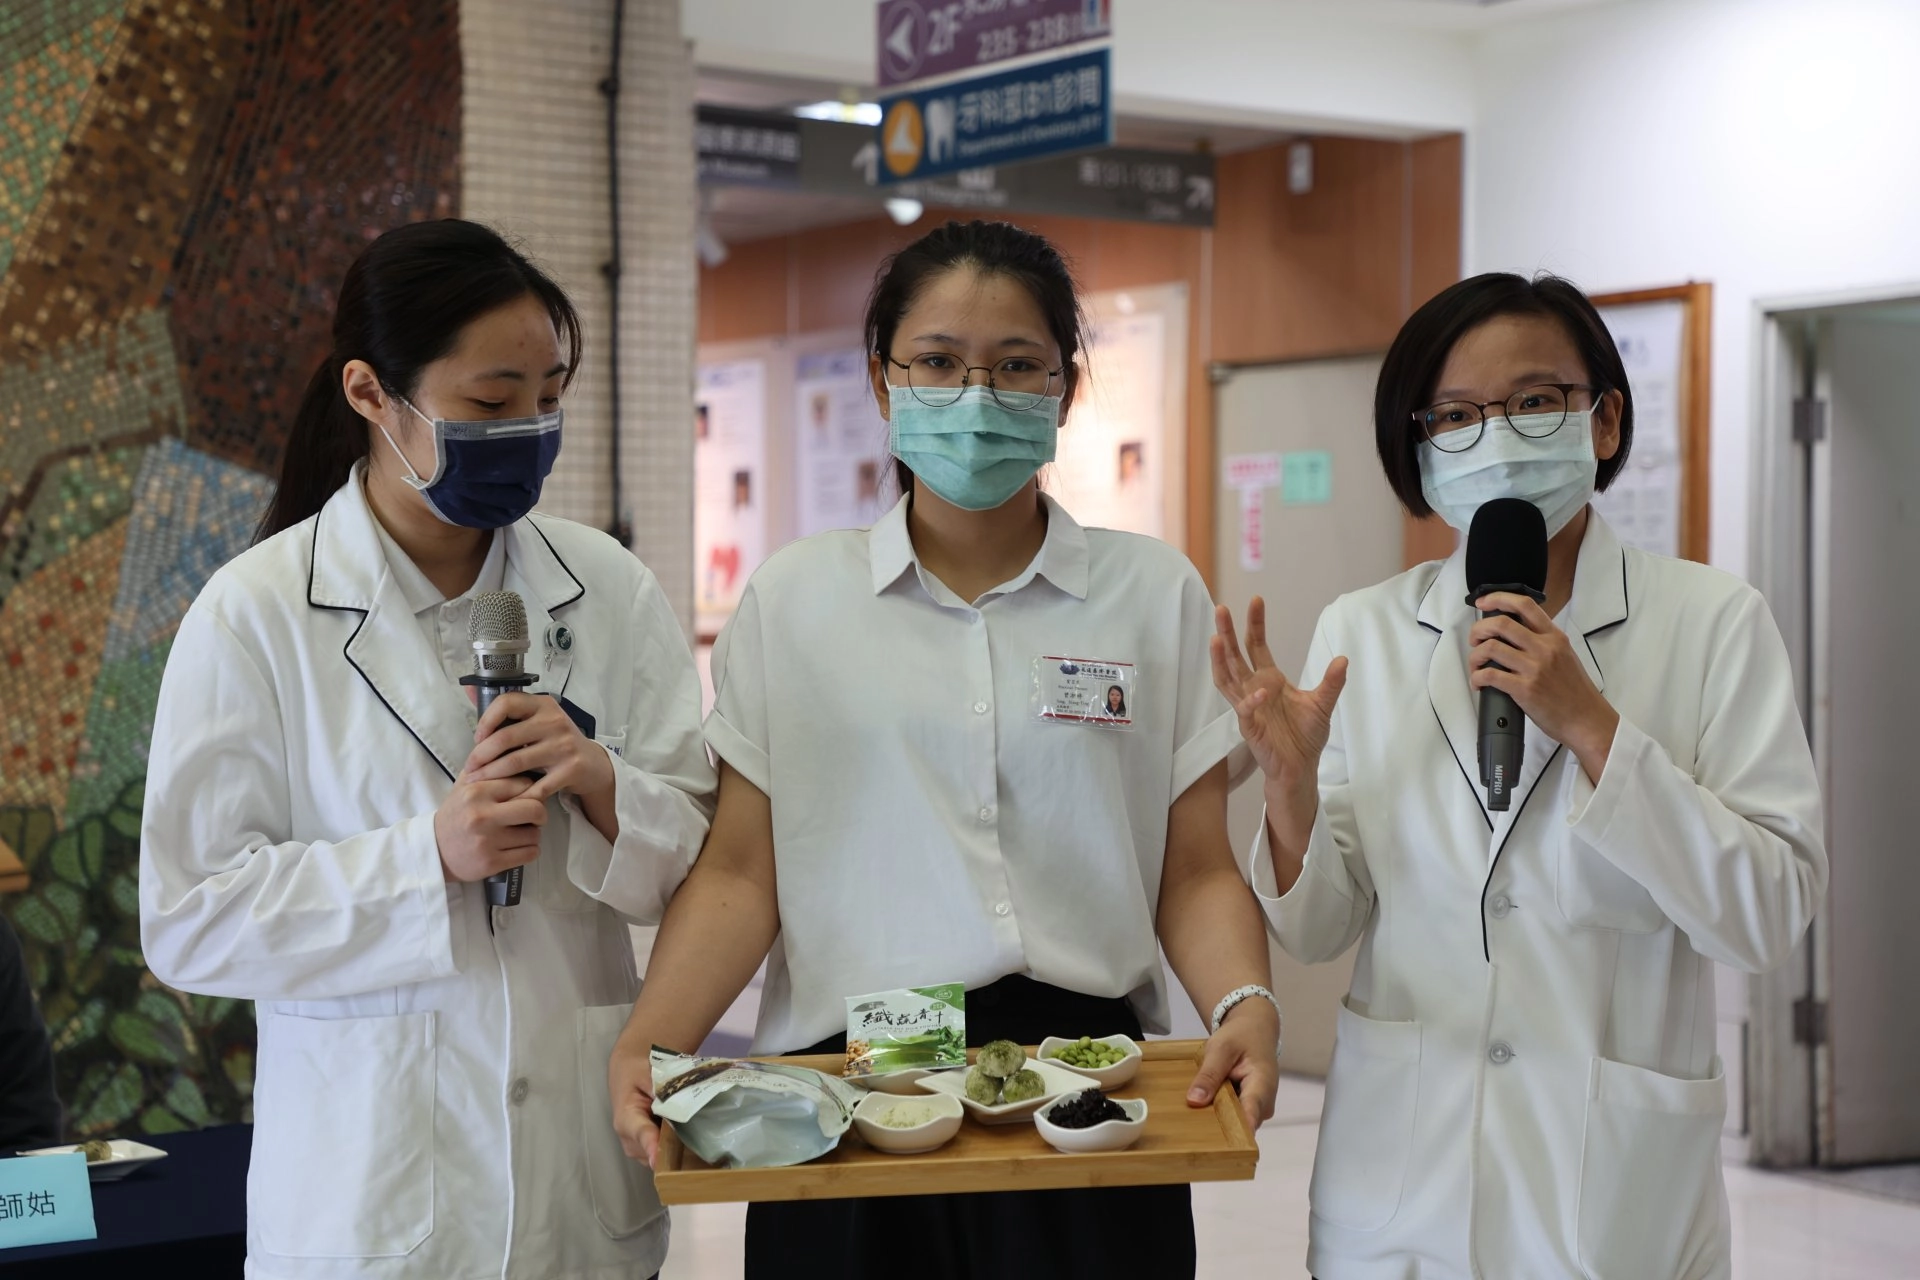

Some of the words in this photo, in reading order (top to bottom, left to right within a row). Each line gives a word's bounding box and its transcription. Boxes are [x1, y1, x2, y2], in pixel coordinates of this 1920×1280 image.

[926, 6, 962, 56] 2F
[1493, 765, 1504, 795] MIPRO
[510, 868, 519, 898] MIPRO
[862, 1008, 944, 1028] 纖蔬青汁
[0, 1189, 56, 1222] 師姑
